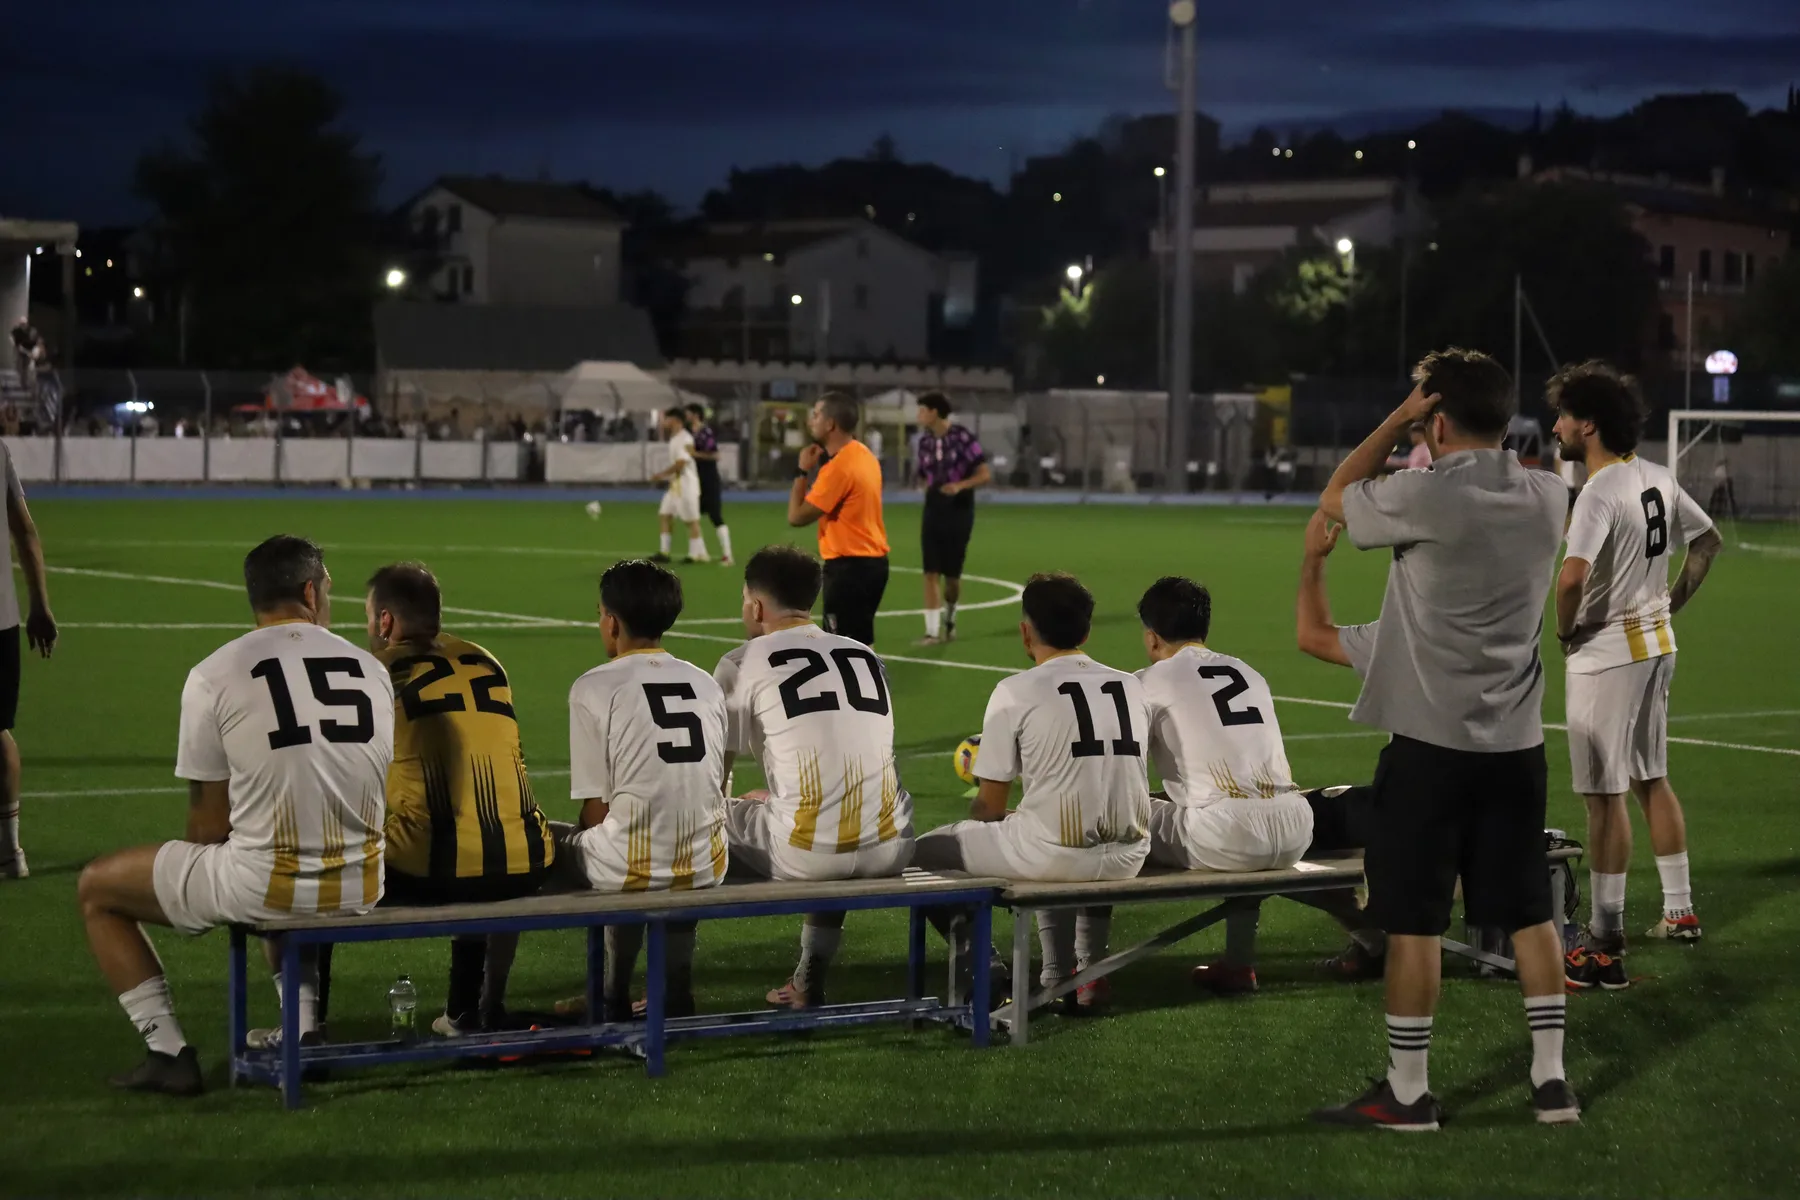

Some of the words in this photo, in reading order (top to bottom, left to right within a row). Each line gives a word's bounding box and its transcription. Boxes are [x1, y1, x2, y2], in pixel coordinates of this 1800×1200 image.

[1641, 487, 1667, 558] 8
[251, 657, 374, 750] 15
[390, 653, 516, 721] 22
[769, 649, 888, 718] 20
[1058, 681, 1140, 757] 11
[1198, 665, 1264, 726] 2
[643, 682, 705, 763] 5
